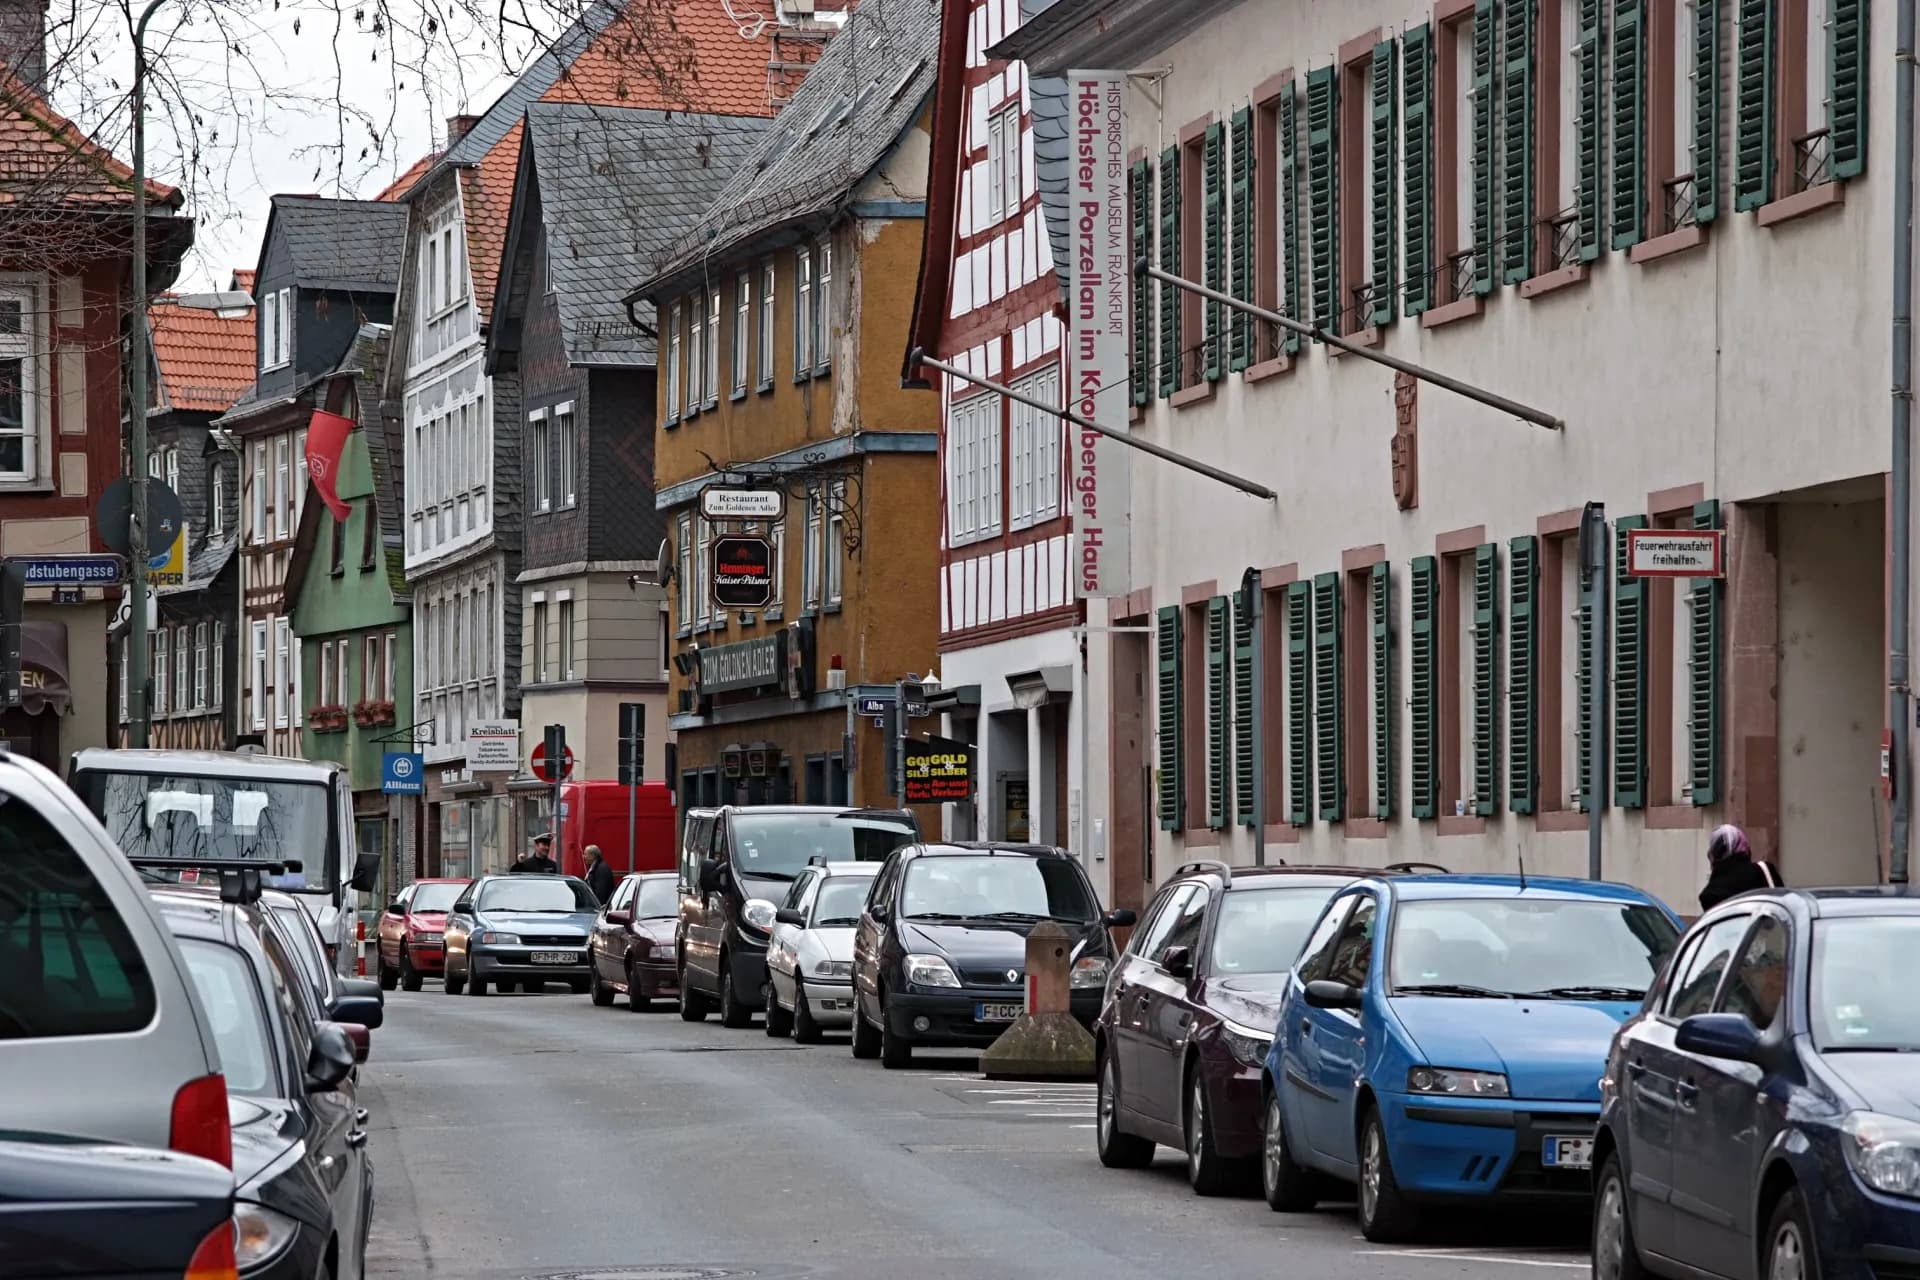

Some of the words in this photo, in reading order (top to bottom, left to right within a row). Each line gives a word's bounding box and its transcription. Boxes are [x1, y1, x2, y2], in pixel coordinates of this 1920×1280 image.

[1107, 81, 1121, 178] HISTORISCHES
[1078, 81, 1101, 193] Höchster
[1108, 184, 1121, 249] MUSEUM
[1079, 201, 1102, 320] Porzellan
[1108, 255, 1122, 336] FRANKFURT
[1080, 329, 1102, 361] im
[719, 494, 768, 503] Restaurant
[708, 504, 724, 512] Zum
[1635, 540, 1712, 552] Feuerwehrausfahrt
[1083, 528, 1103, 592] Haus
[1652, 554, 1696, 565] freihalten
[703, 655, 718, 685] ZUM
[752, 645, 776, 679] ADLER
[471, 727, 516, 736] Kreisblatt
[930, 754, 968, 765] GOLD
[944, 760, 955, 770] &
[930, 767, 968, 777] SILBER
[384, 780, 420, 790] Allianz
[983, 1005, 992, 1018] F
[999, 1005, 1015, 1018] CC
[1558, 1141, 1572, 1162] F
